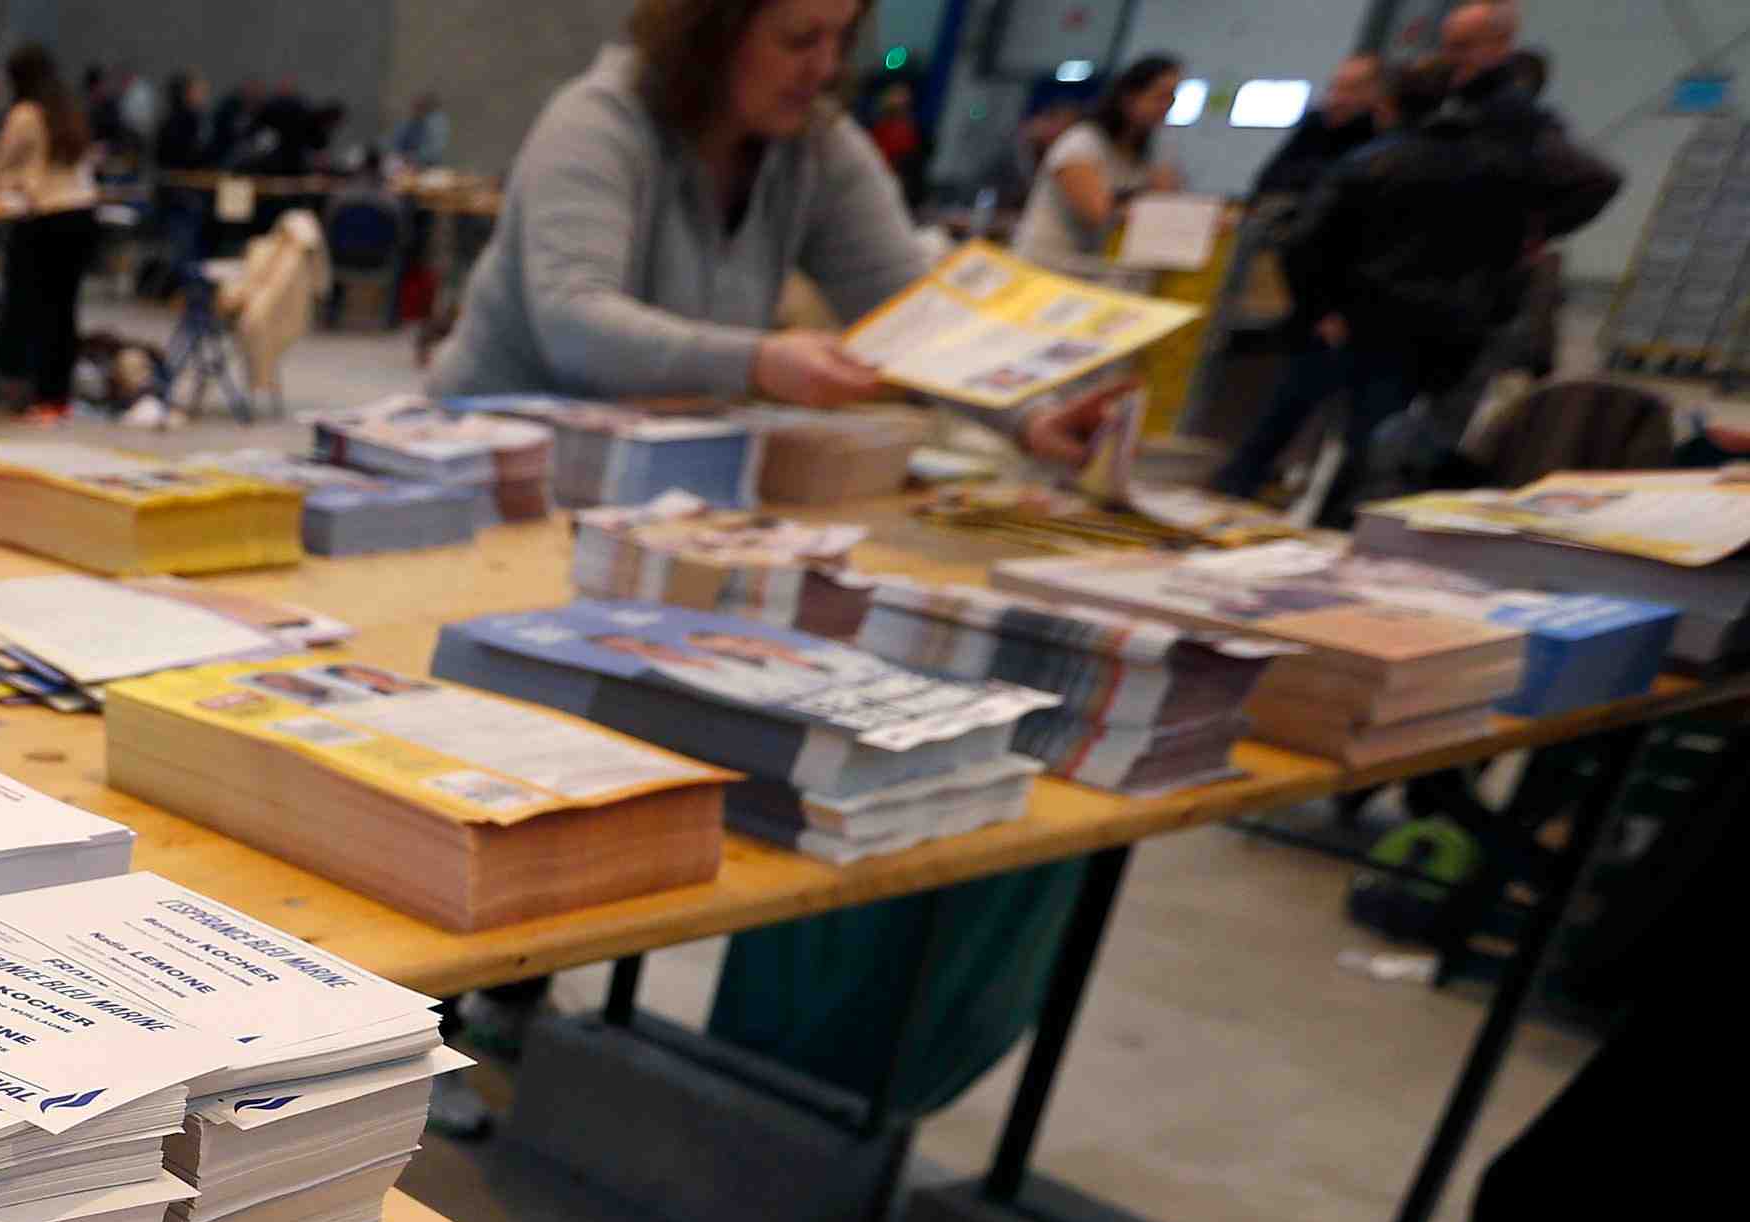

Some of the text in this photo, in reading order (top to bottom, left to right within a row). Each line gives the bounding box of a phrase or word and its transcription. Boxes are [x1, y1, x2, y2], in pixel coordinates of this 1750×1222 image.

[129, 950, 217, 994] LEMOINE
[200, 943, 280, 983] KOCHER
[42, 979, 97, 1002] BLEU
[86, 997, 176, 1032] MARINE
